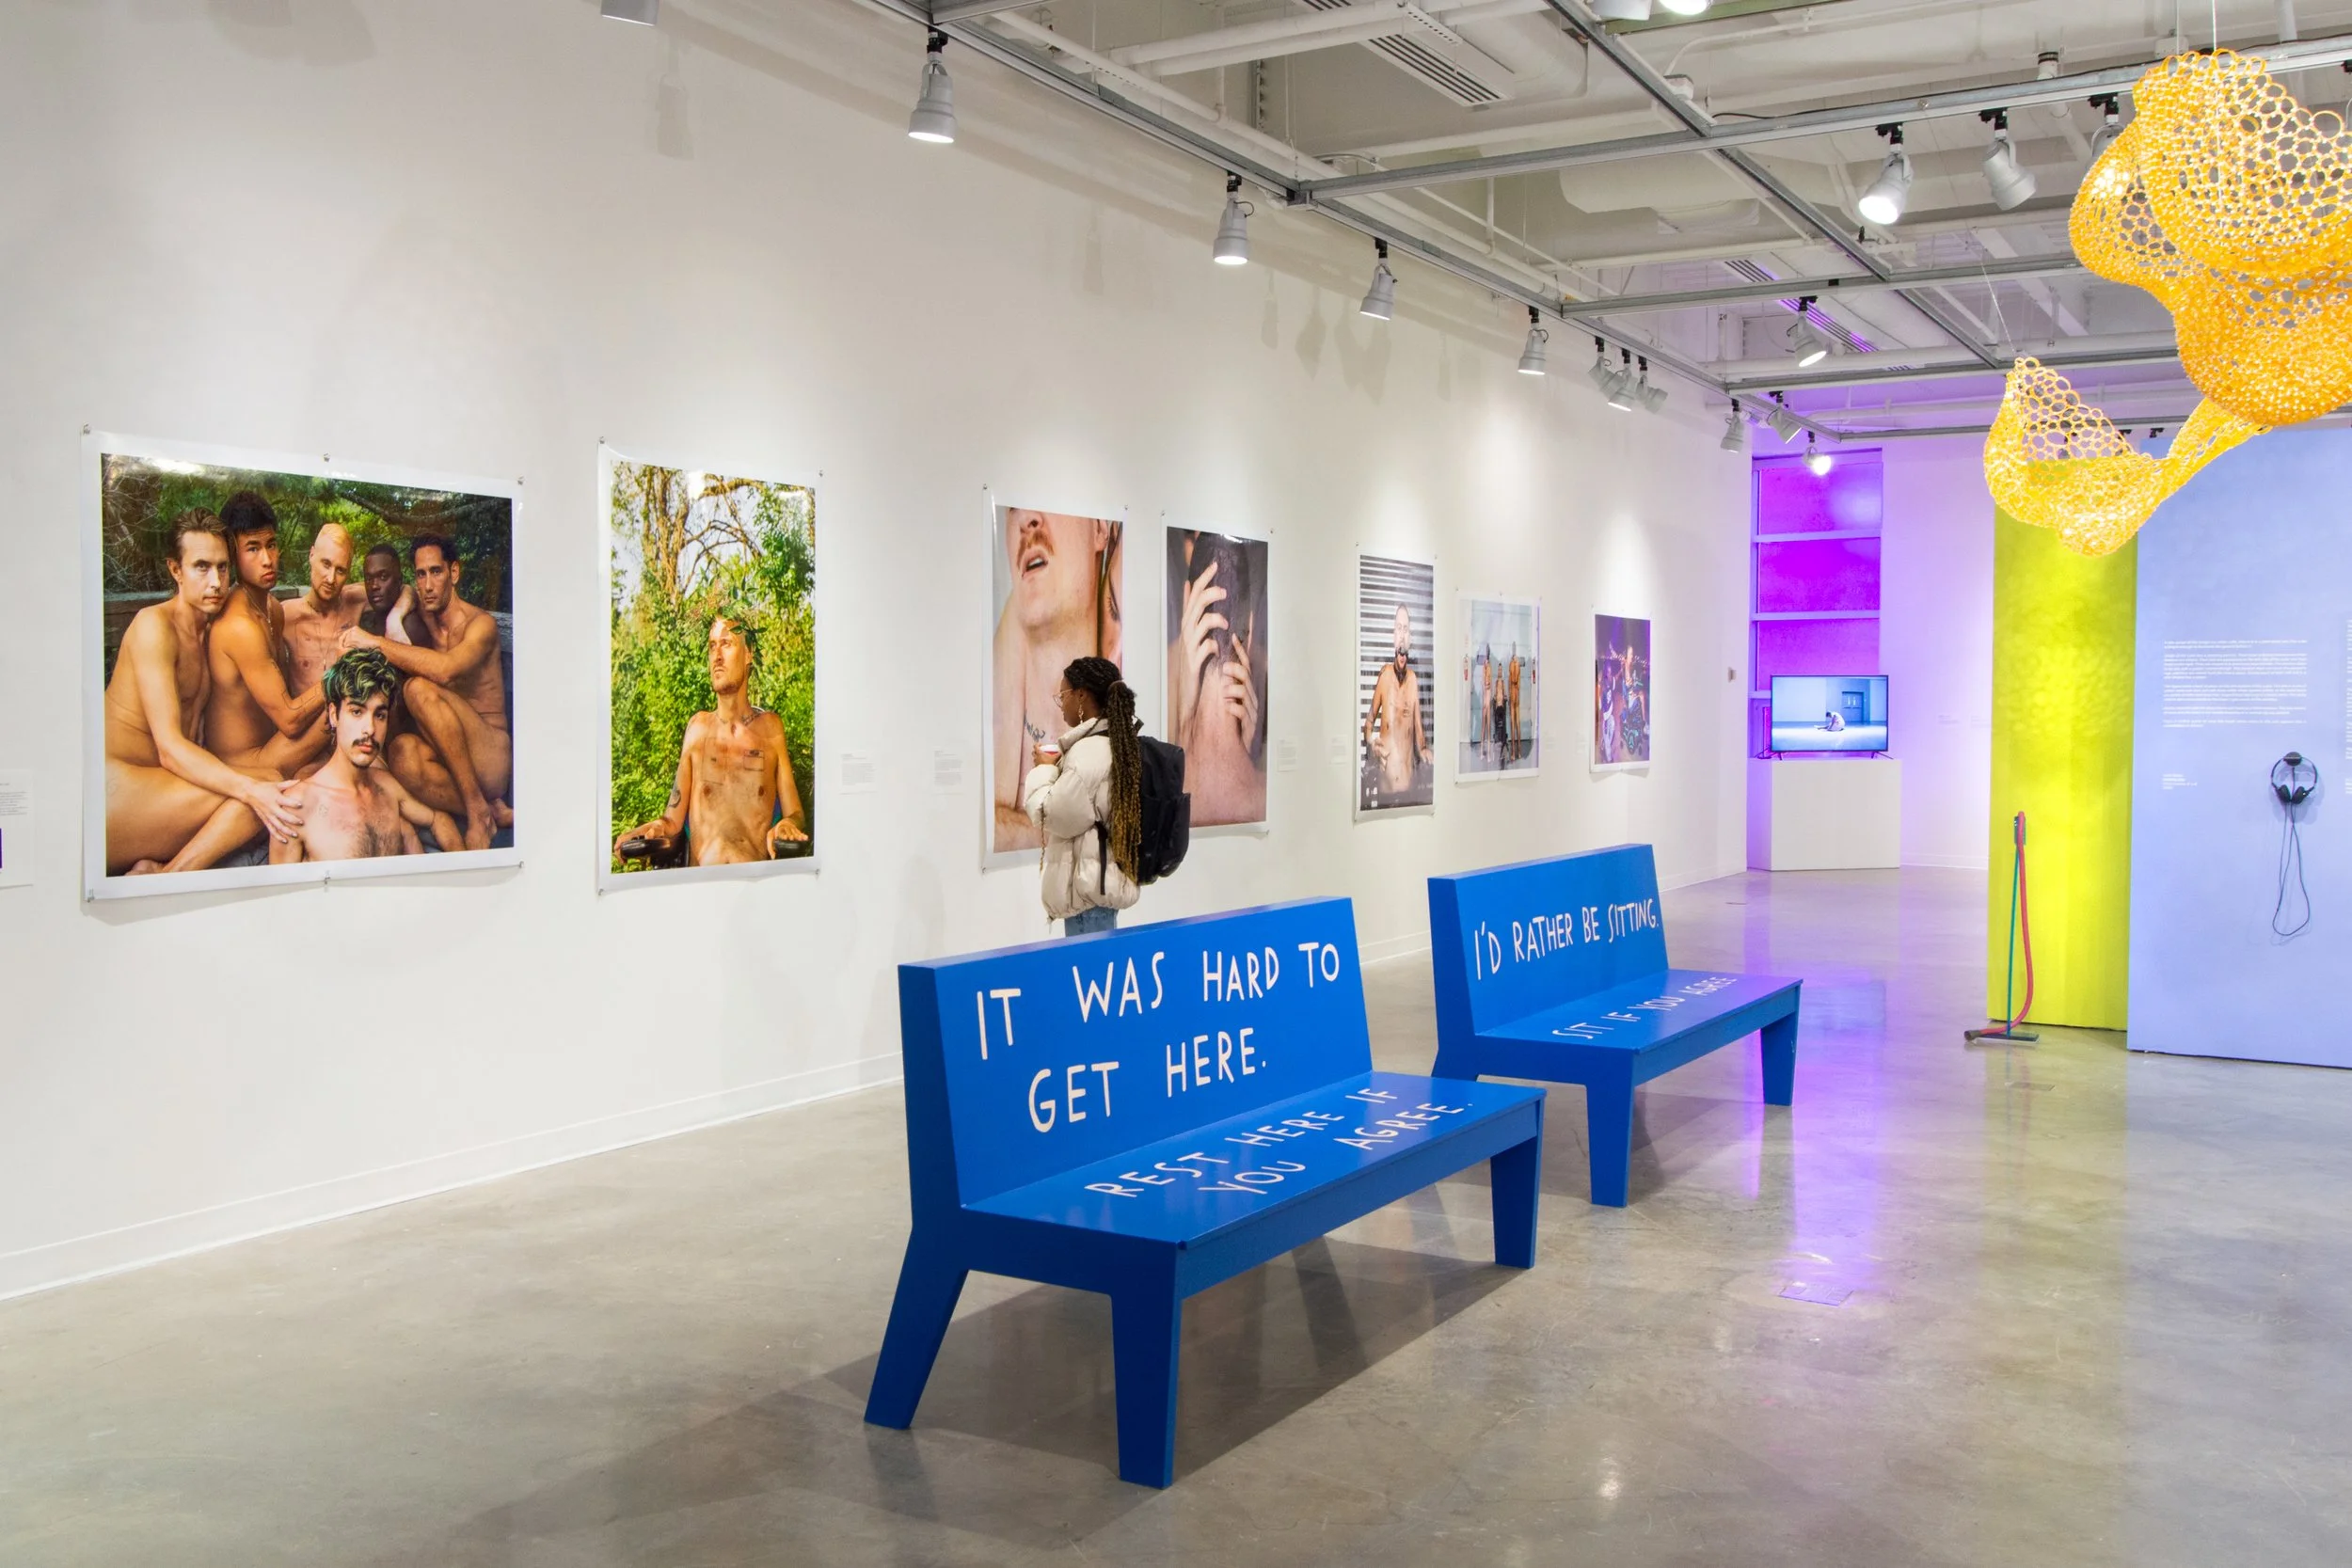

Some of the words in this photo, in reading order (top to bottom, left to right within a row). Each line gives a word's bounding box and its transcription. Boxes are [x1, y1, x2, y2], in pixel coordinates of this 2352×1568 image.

[1474, 921, 1502, 980] I'D
[1512, 912, 1574, 962] RATHER
[1581, 906, 1600, 943] BE
[1607, 898, 1660, 944] SITTING.
[977, 989, 1022, 1060] IT
[1073, 951, 1166, 1023] WAS
[1203, 946, 1279, 1002] HARD
[1297, 942, 1340, 988] TO
[1551, 1022, 1614, 1039] SIT
[1600, 1011, 1641, 1022] IF
[1627, 995, 1686, 1011] YOU
[1677, 976, 1738, 996] AGREE
[1028, 1061, 1120, 1133] GET
[1166, 1027, 1267, 1098] HERE.
[1084, 1151, 1230, 1197] REST
[1225, 1111, 1344, 1147] HERE
[1345, 1087, 1399, 1105] IF
[1198, 1161, 1306, 1195] YOU
